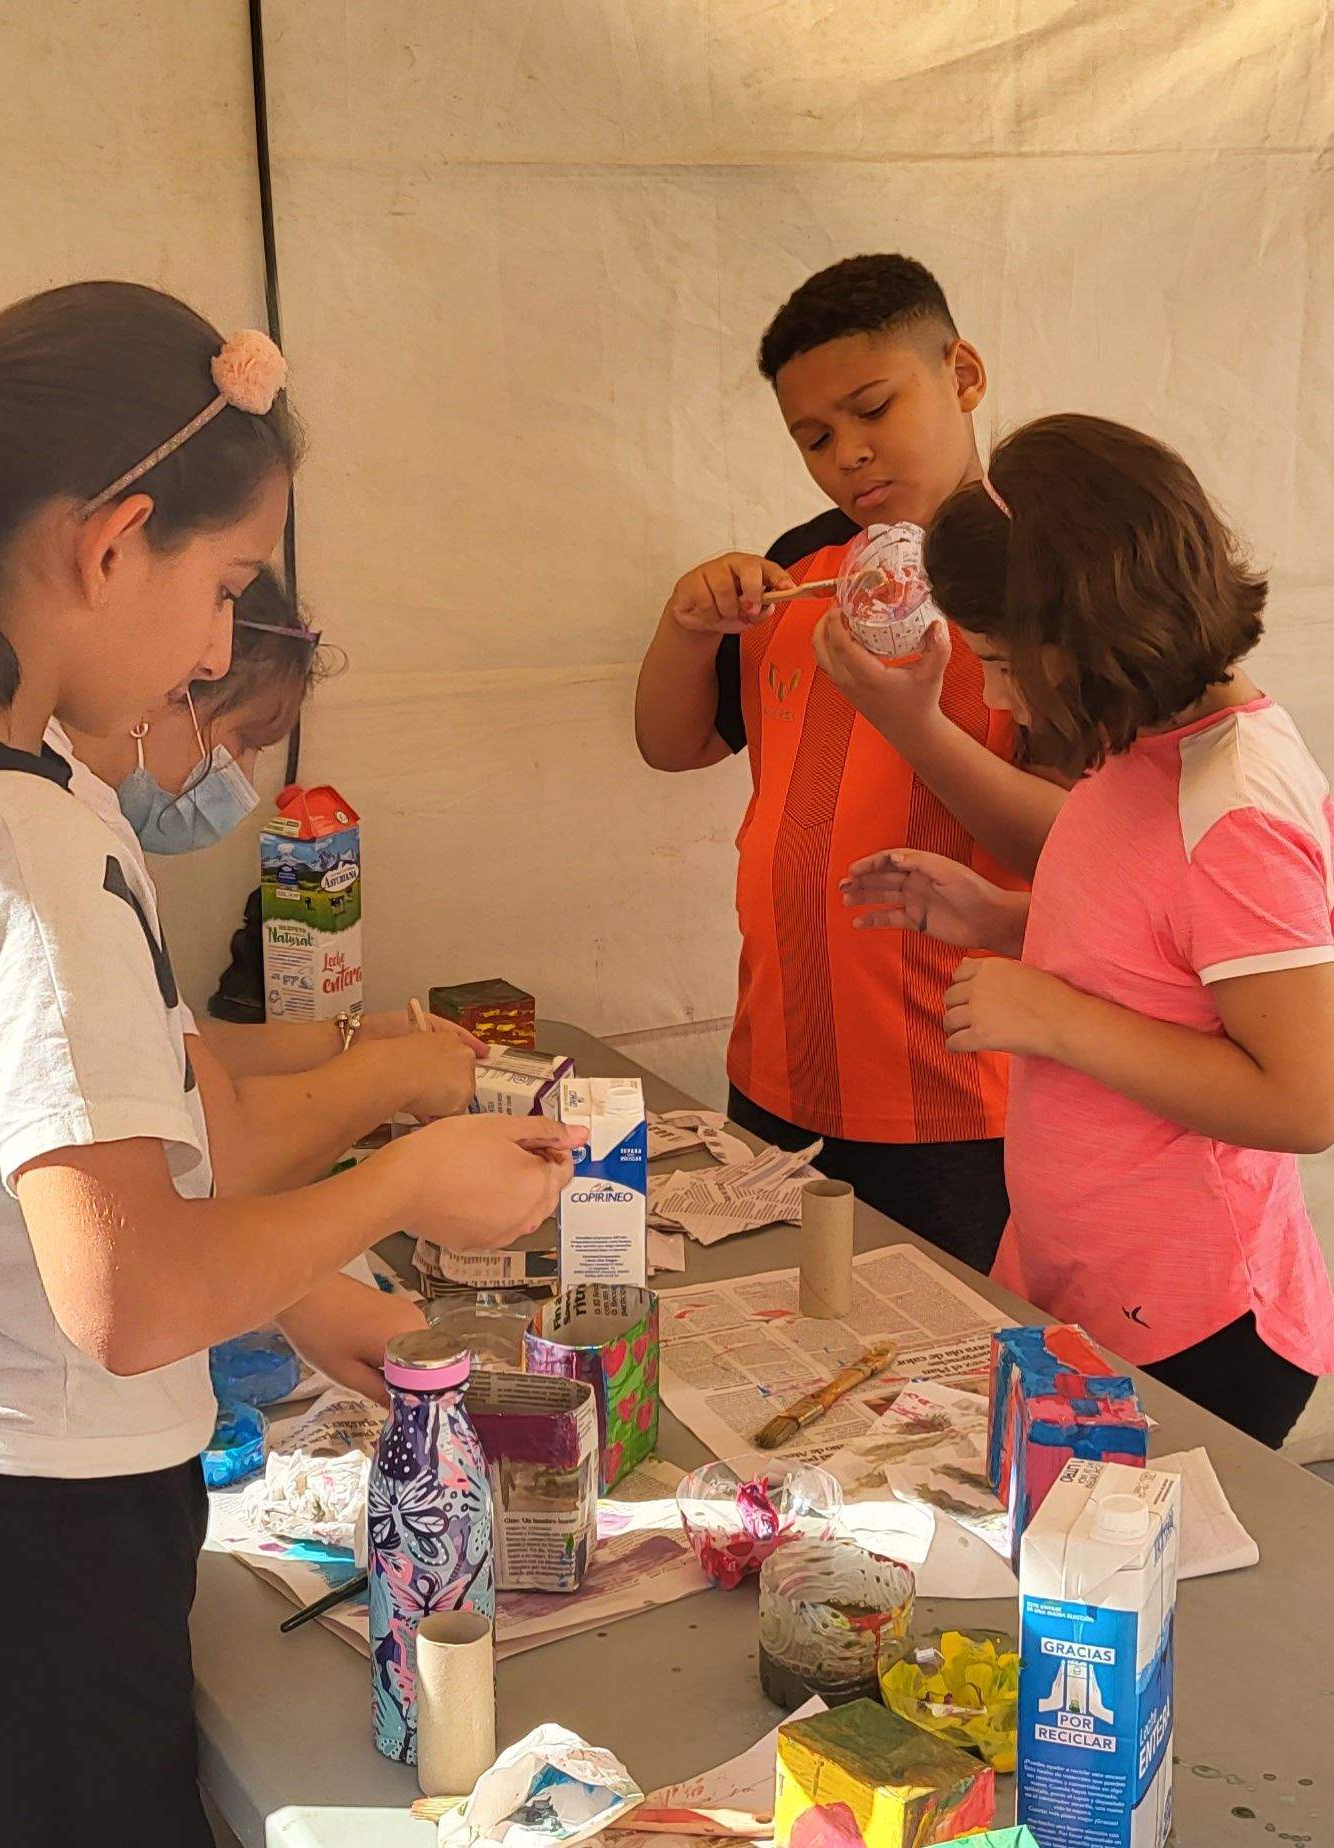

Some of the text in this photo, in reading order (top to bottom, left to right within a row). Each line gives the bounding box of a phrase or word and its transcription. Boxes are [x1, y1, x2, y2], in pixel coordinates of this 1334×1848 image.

[268, 926, 312, 947] Natural
[322, 951, 345, 972] Leche
[571, 1191, 634, 1204] COPIRINEO
[1043, 1640, 1112, 1662] GRACIAS
[1059, 1714, 1092, 1730] POR
[1038, 1727, 1113, 1750] RECICLAR
